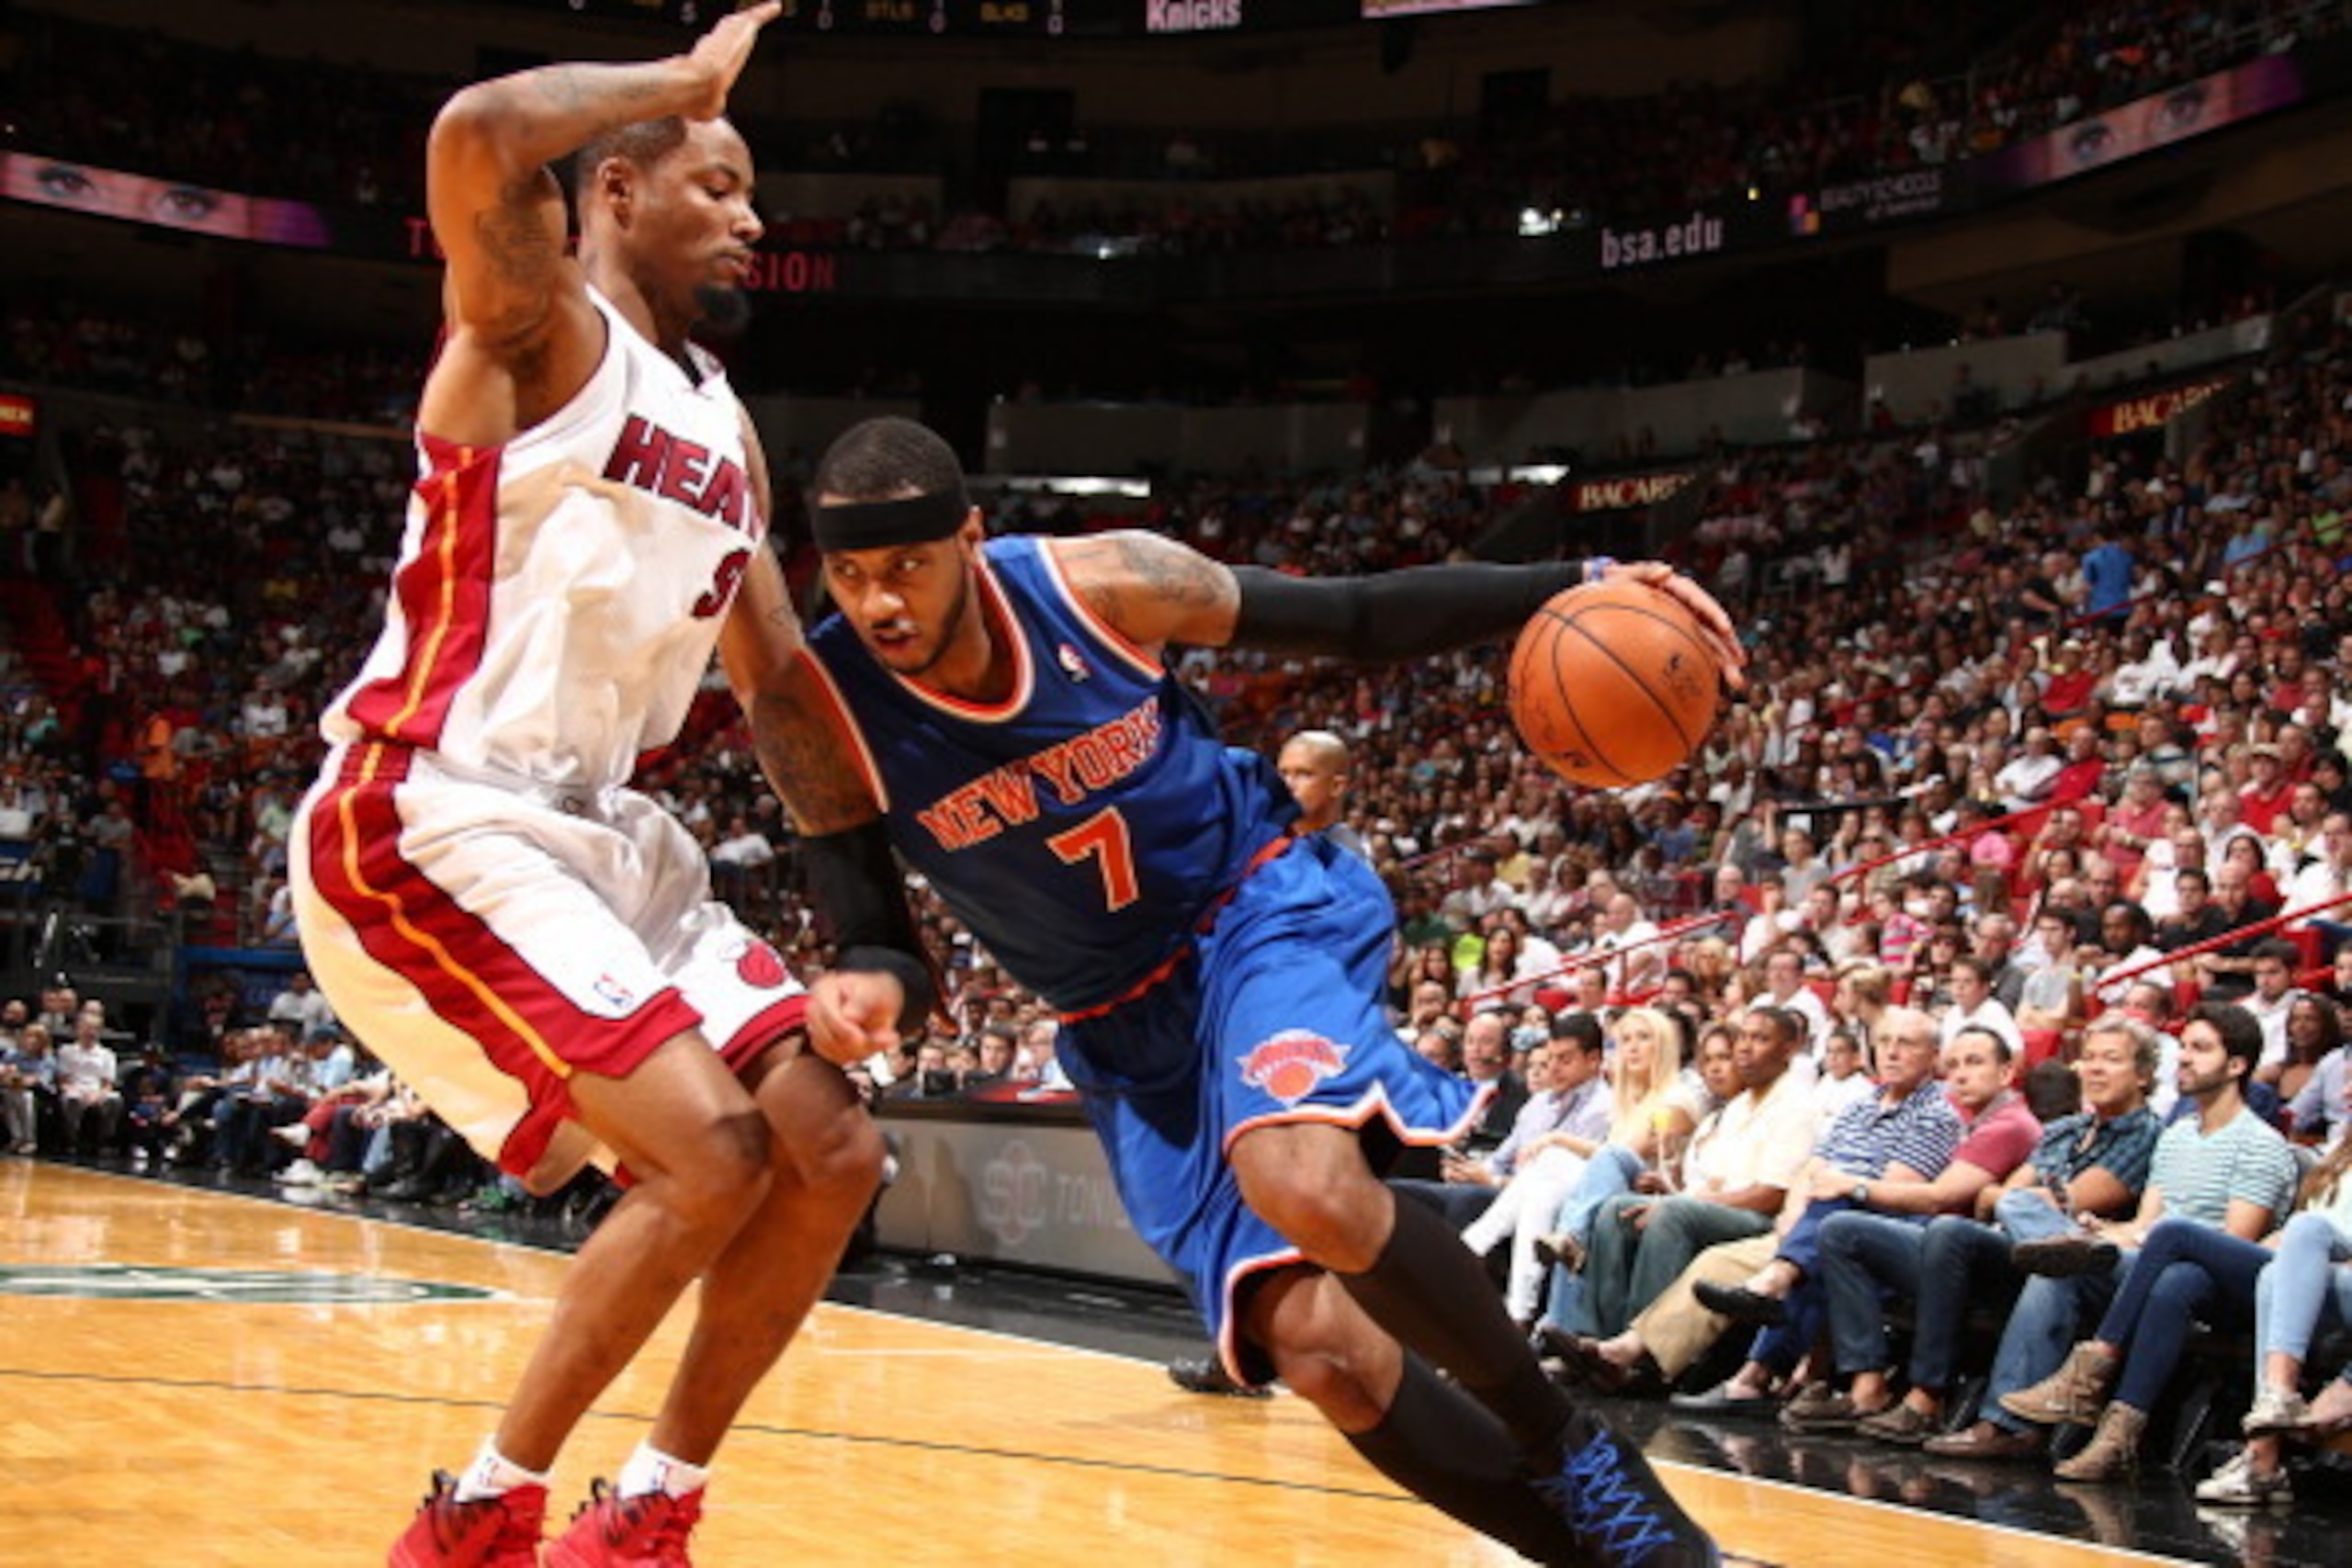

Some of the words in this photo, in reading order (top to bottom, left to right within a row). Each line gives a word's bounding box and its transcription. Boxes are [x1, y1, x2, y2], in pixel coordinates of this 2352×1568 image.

[1146, 0, 1241, 34] Knicks
[1600, 210, 1724, 269] bsa.edu
[916, 762, 1040, 852] NEW
[1028, 695, 1161, 805] YORK
[1044, 805, 1140, 912] 7
